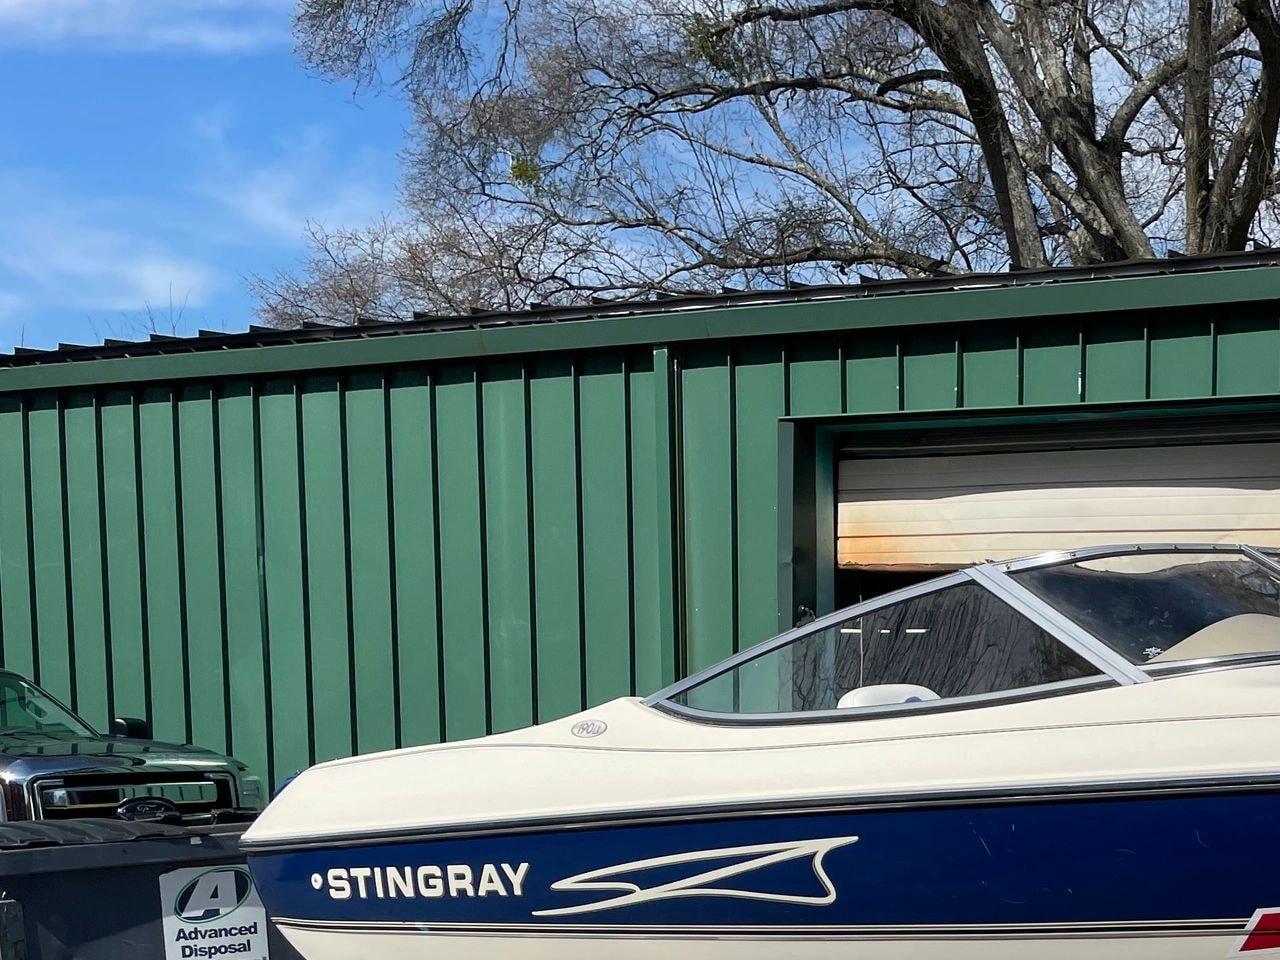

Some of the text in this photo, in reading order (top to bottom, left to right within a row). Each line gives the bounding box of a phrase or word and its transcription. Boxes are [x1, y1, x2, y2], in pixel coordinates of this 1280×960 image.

[327, 862, 529, 900] STINGRAY
[175, 922, 258, 942] Advanced
[180, 939, 251, 959] Disposal
